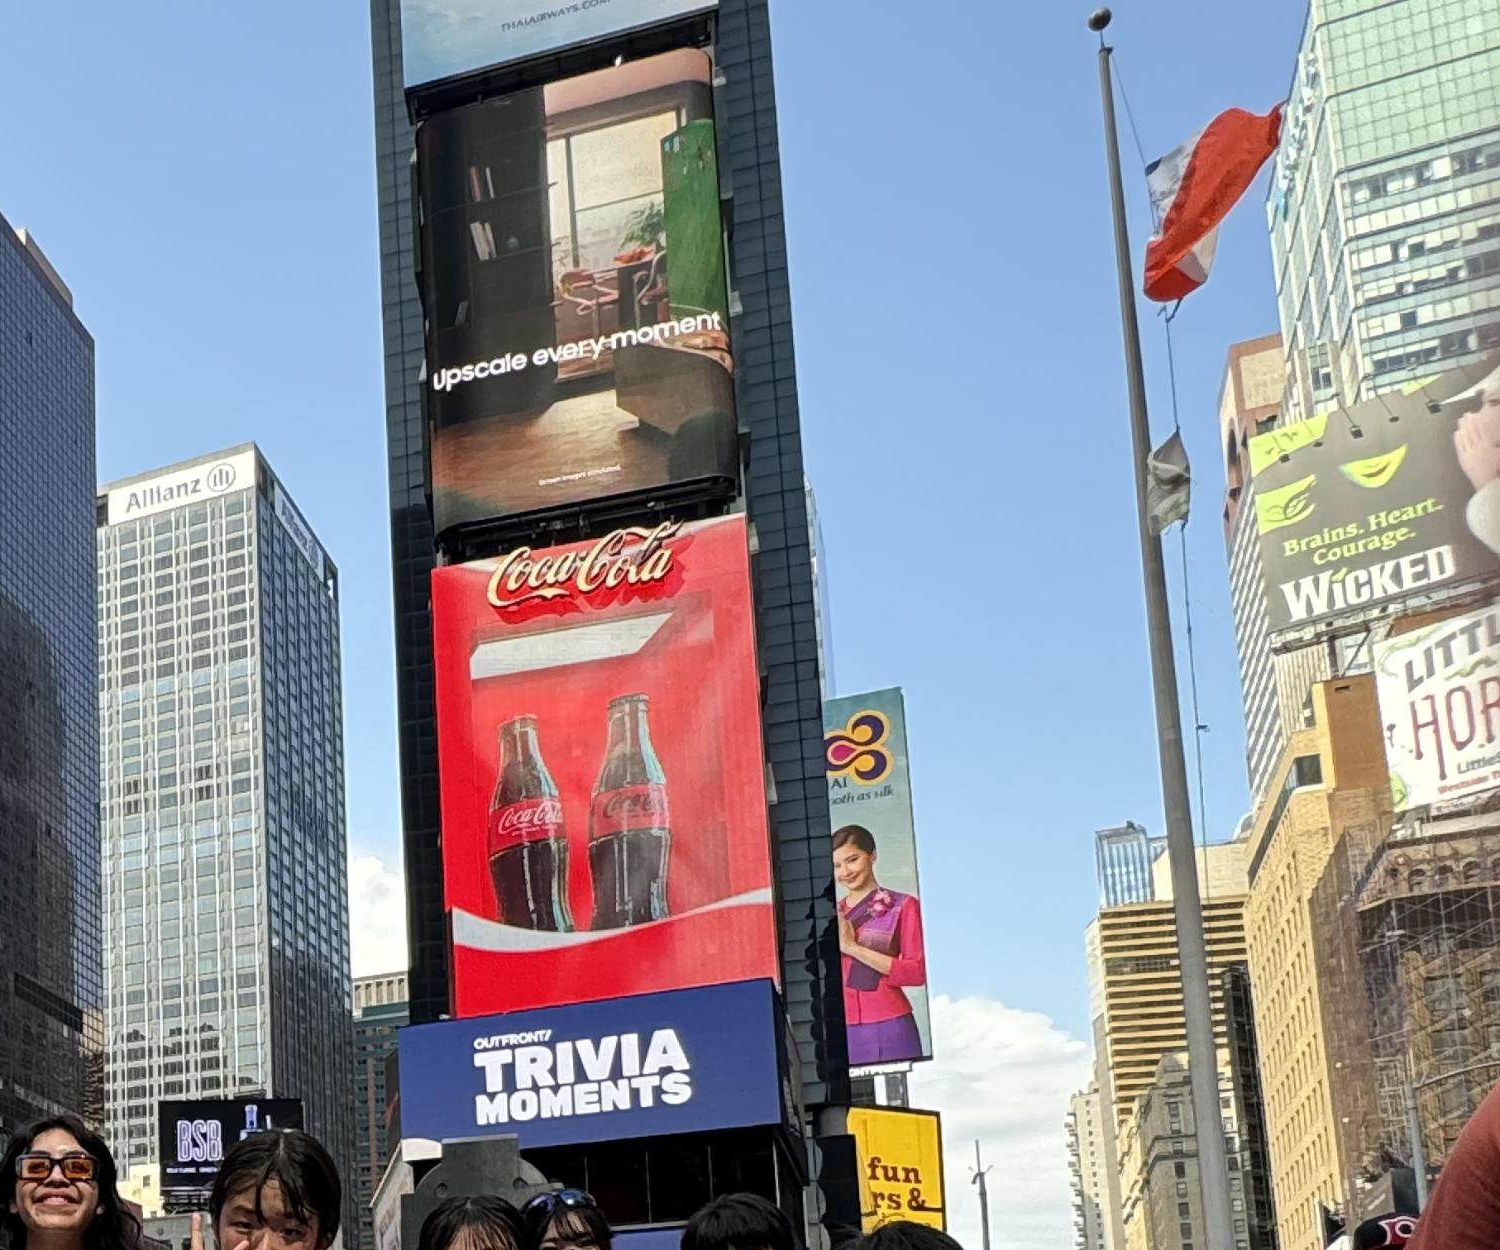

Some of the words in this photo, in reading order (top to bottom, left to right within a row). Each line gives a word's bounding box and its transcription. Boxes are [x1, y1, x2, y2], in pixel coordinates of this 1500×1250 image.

[532, 336, 607, 366] every
[611, 311, 721, 349] moment
[125, 477, 202, 513] Allianz
[1283, 522, 1365, 556] Brains.
[1367, 498, 1445, 531] Heart.
[1313, 527, 1417, 565] Courage.
[486, 519, 684, 607] Coca-Cola
[498, 800, 564, 835] Coca-Cola
[473, 1028, 690, 1093] TRIVIA
[475, 1072, 692, 1126] MOMENTS
[867, 1156, 922, 1184] fun
